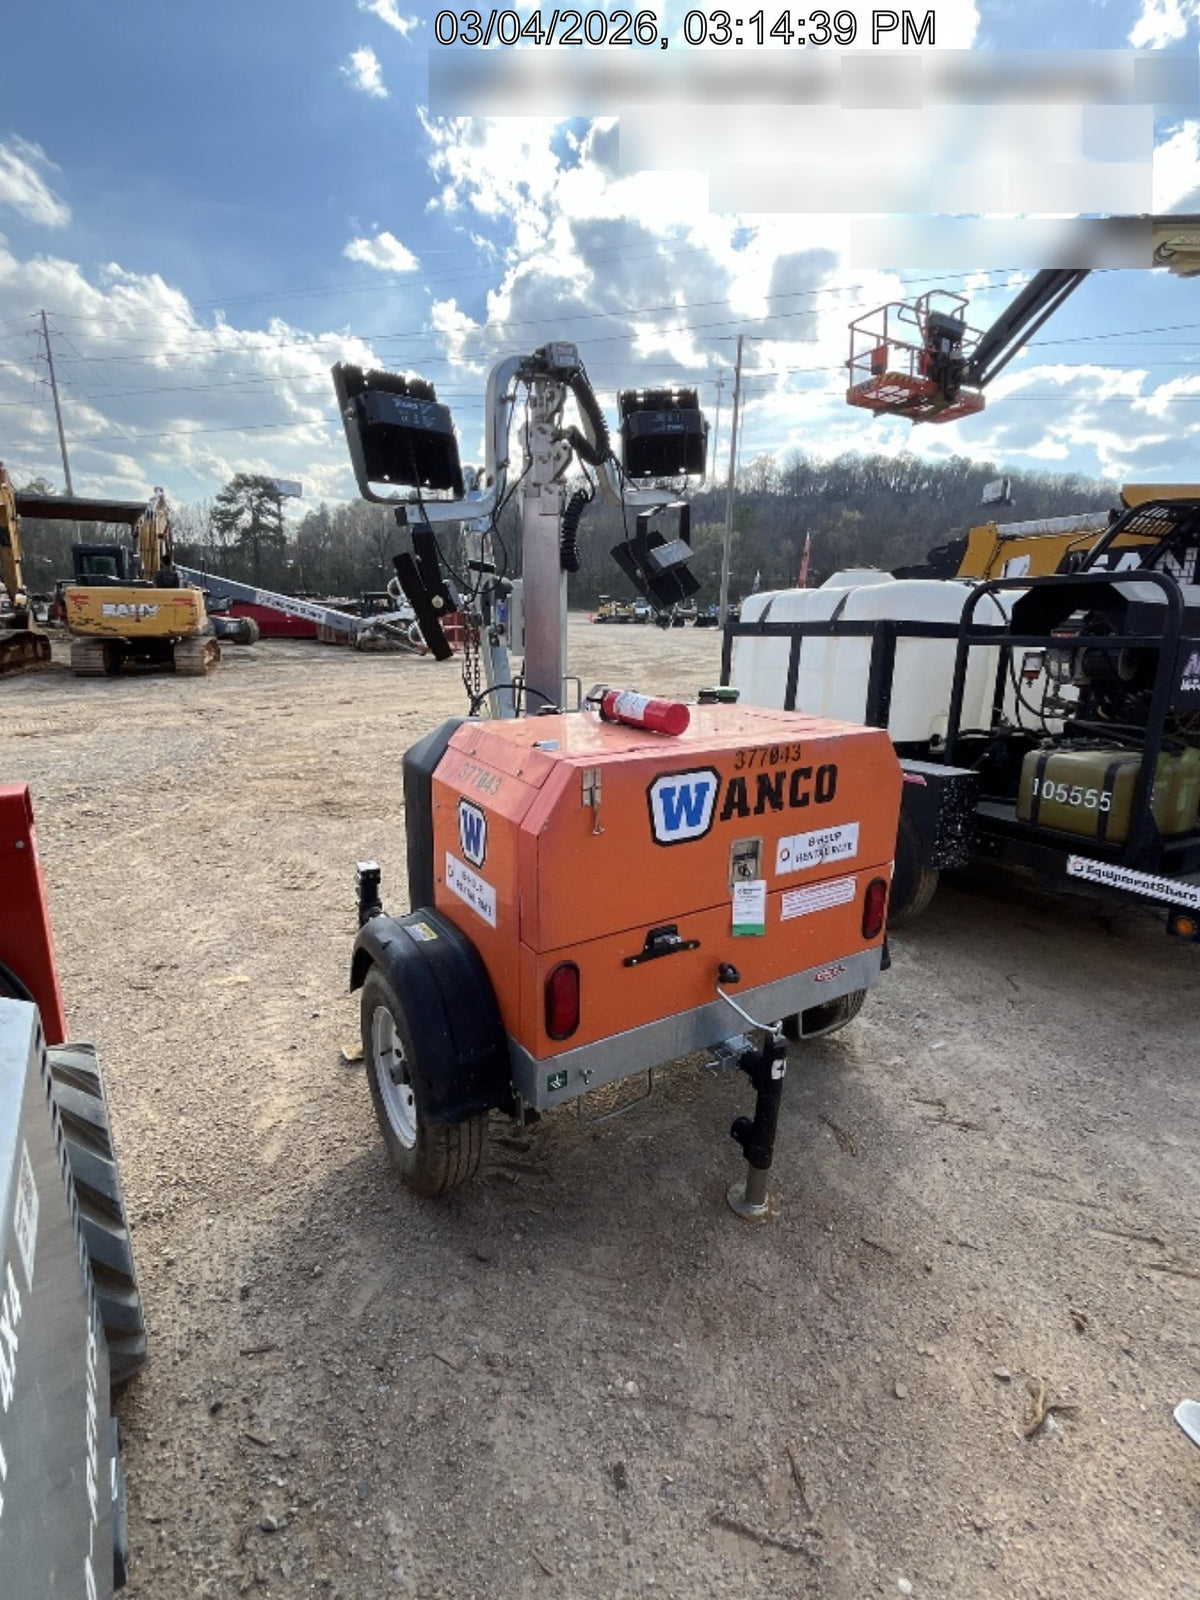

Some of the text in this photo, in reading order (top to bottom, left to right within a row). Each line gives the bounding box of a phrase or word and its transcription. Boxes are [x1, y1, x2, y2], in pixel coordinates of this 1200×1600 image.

[658, 763, 839, 831] WANCO
[1033, 778, 1112, 812] 105555
[1086, 864, 1198, 902] EquipmentShare
